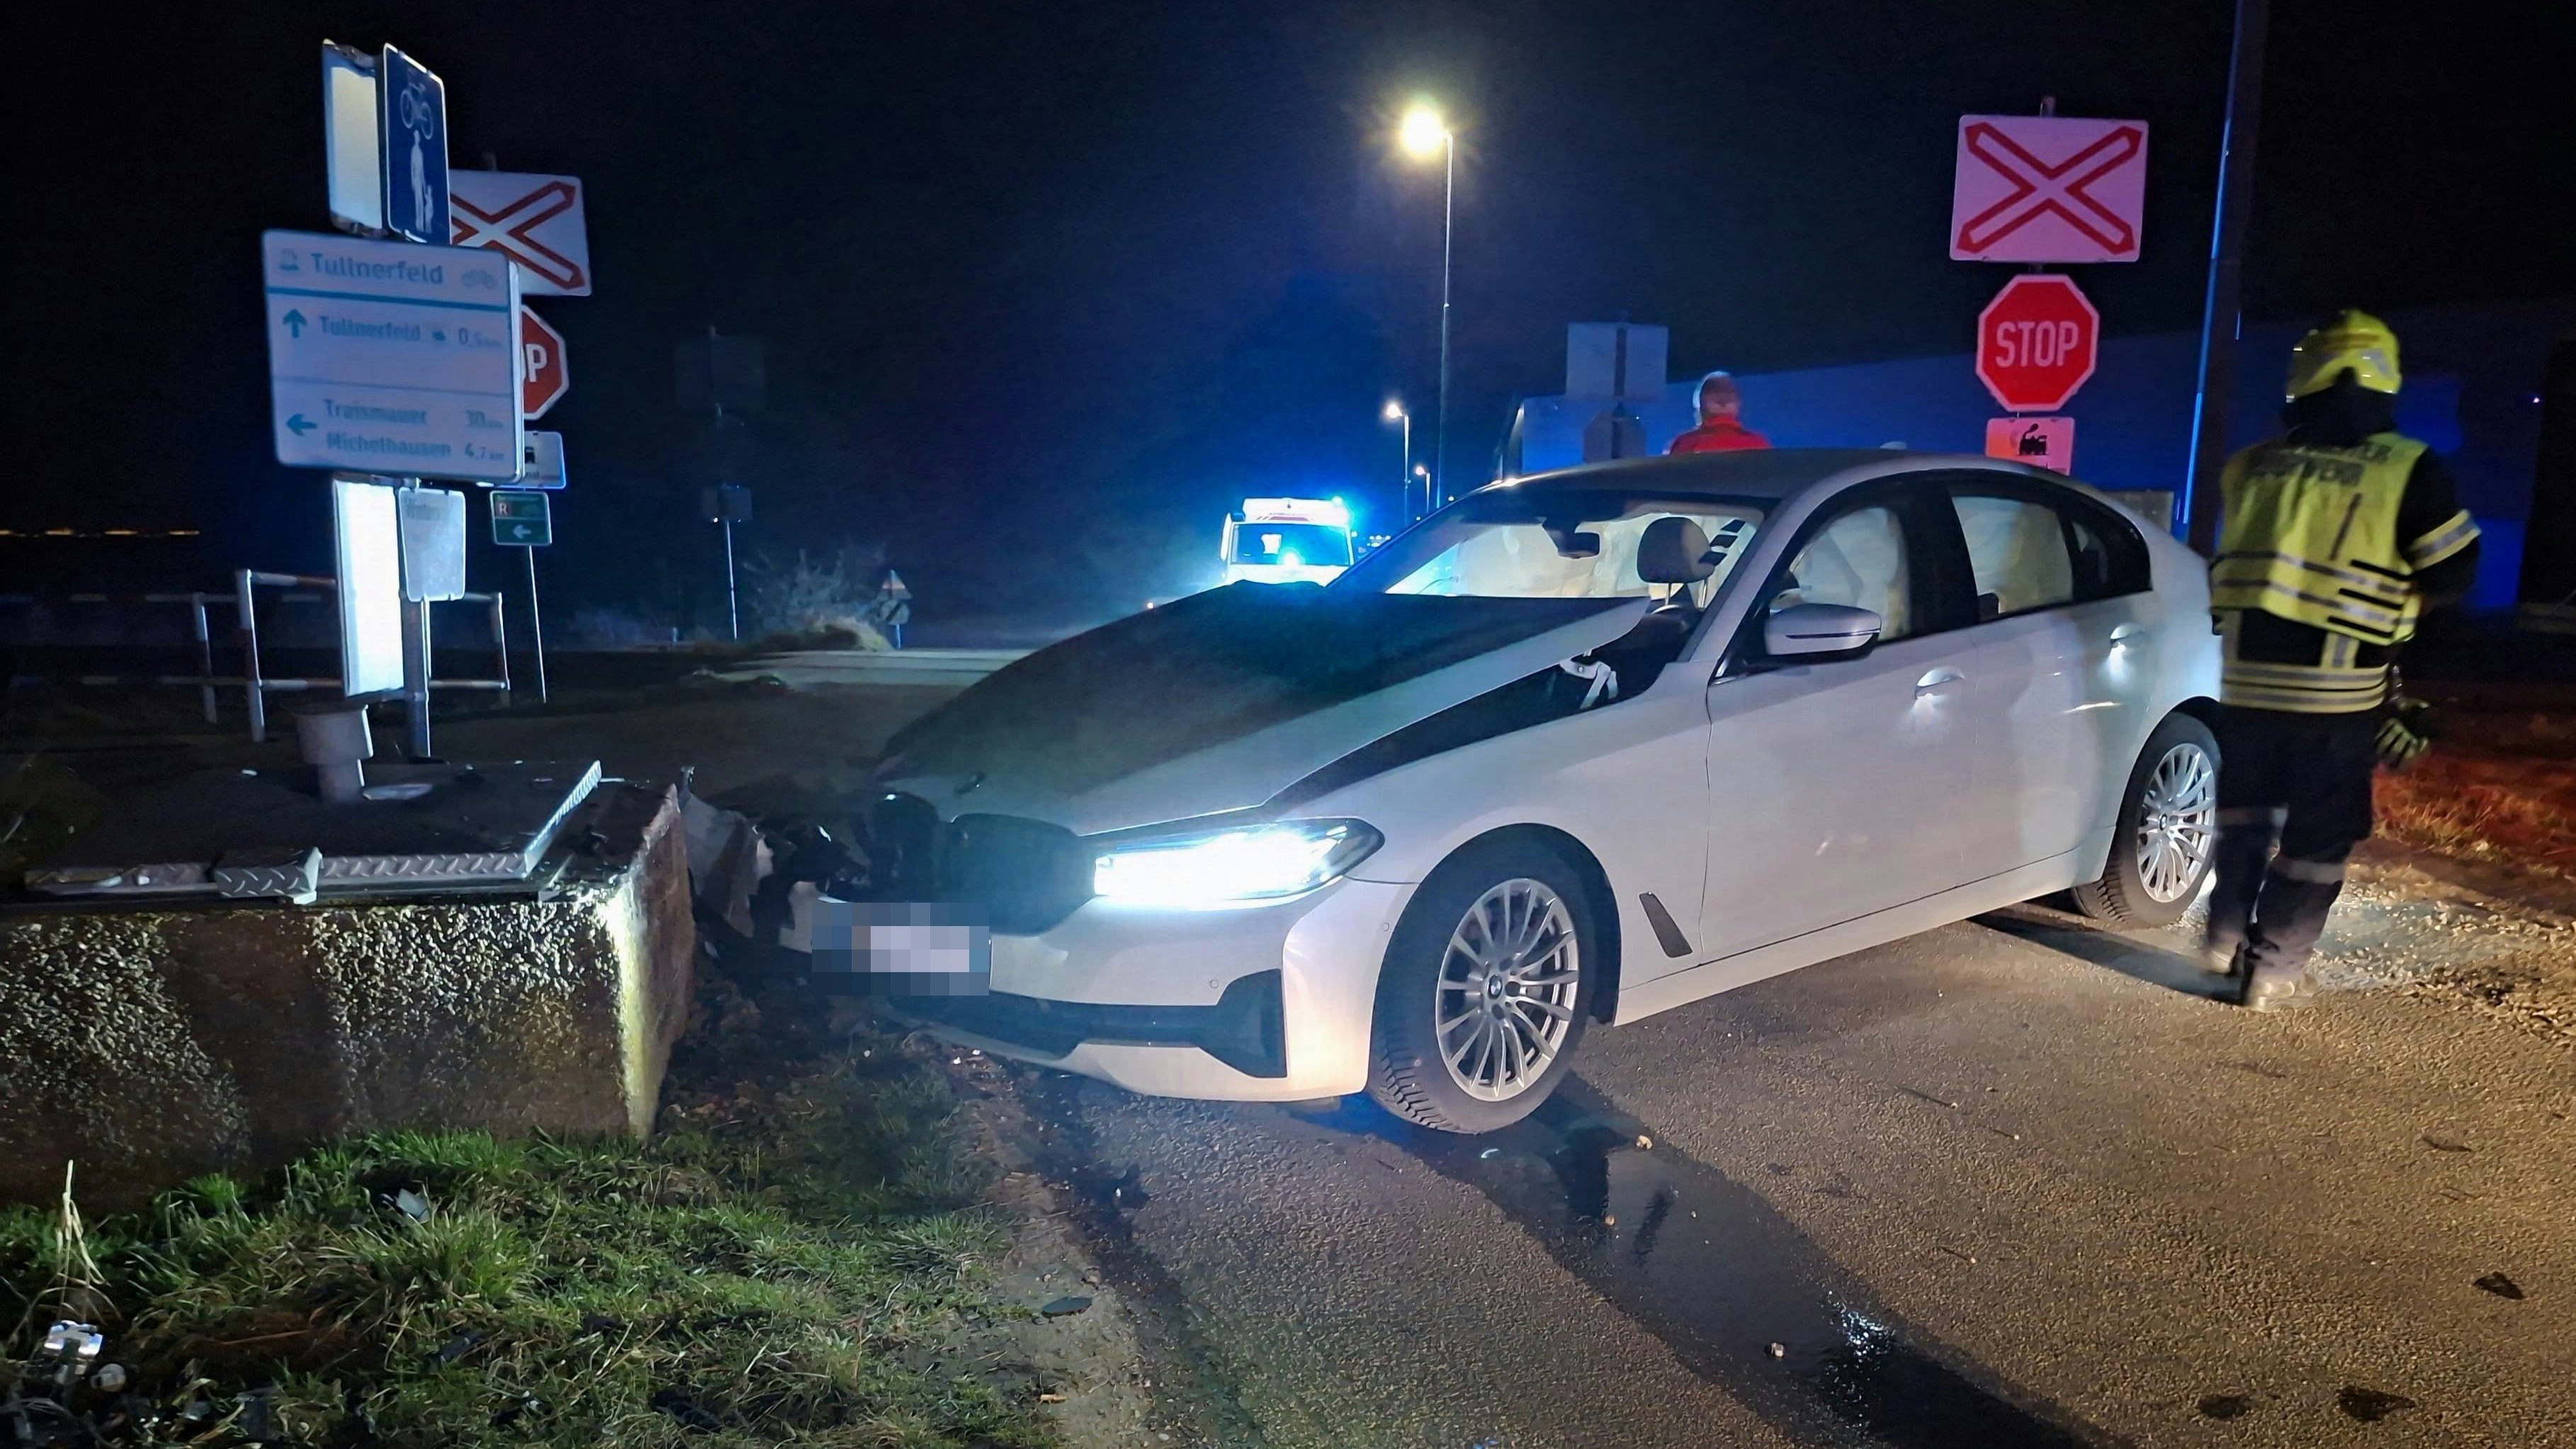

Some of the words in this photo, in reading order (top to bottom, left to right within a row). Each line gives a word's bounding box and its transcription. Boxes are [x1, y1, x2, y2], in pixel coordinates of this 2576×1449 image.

[310, 252, 444, 285] Tullnerfeld
[318, 315, 421, 342] Tullnerfeld
[1995, 320, 2079, 368] STOP
[498, 502, 509, 516] R
